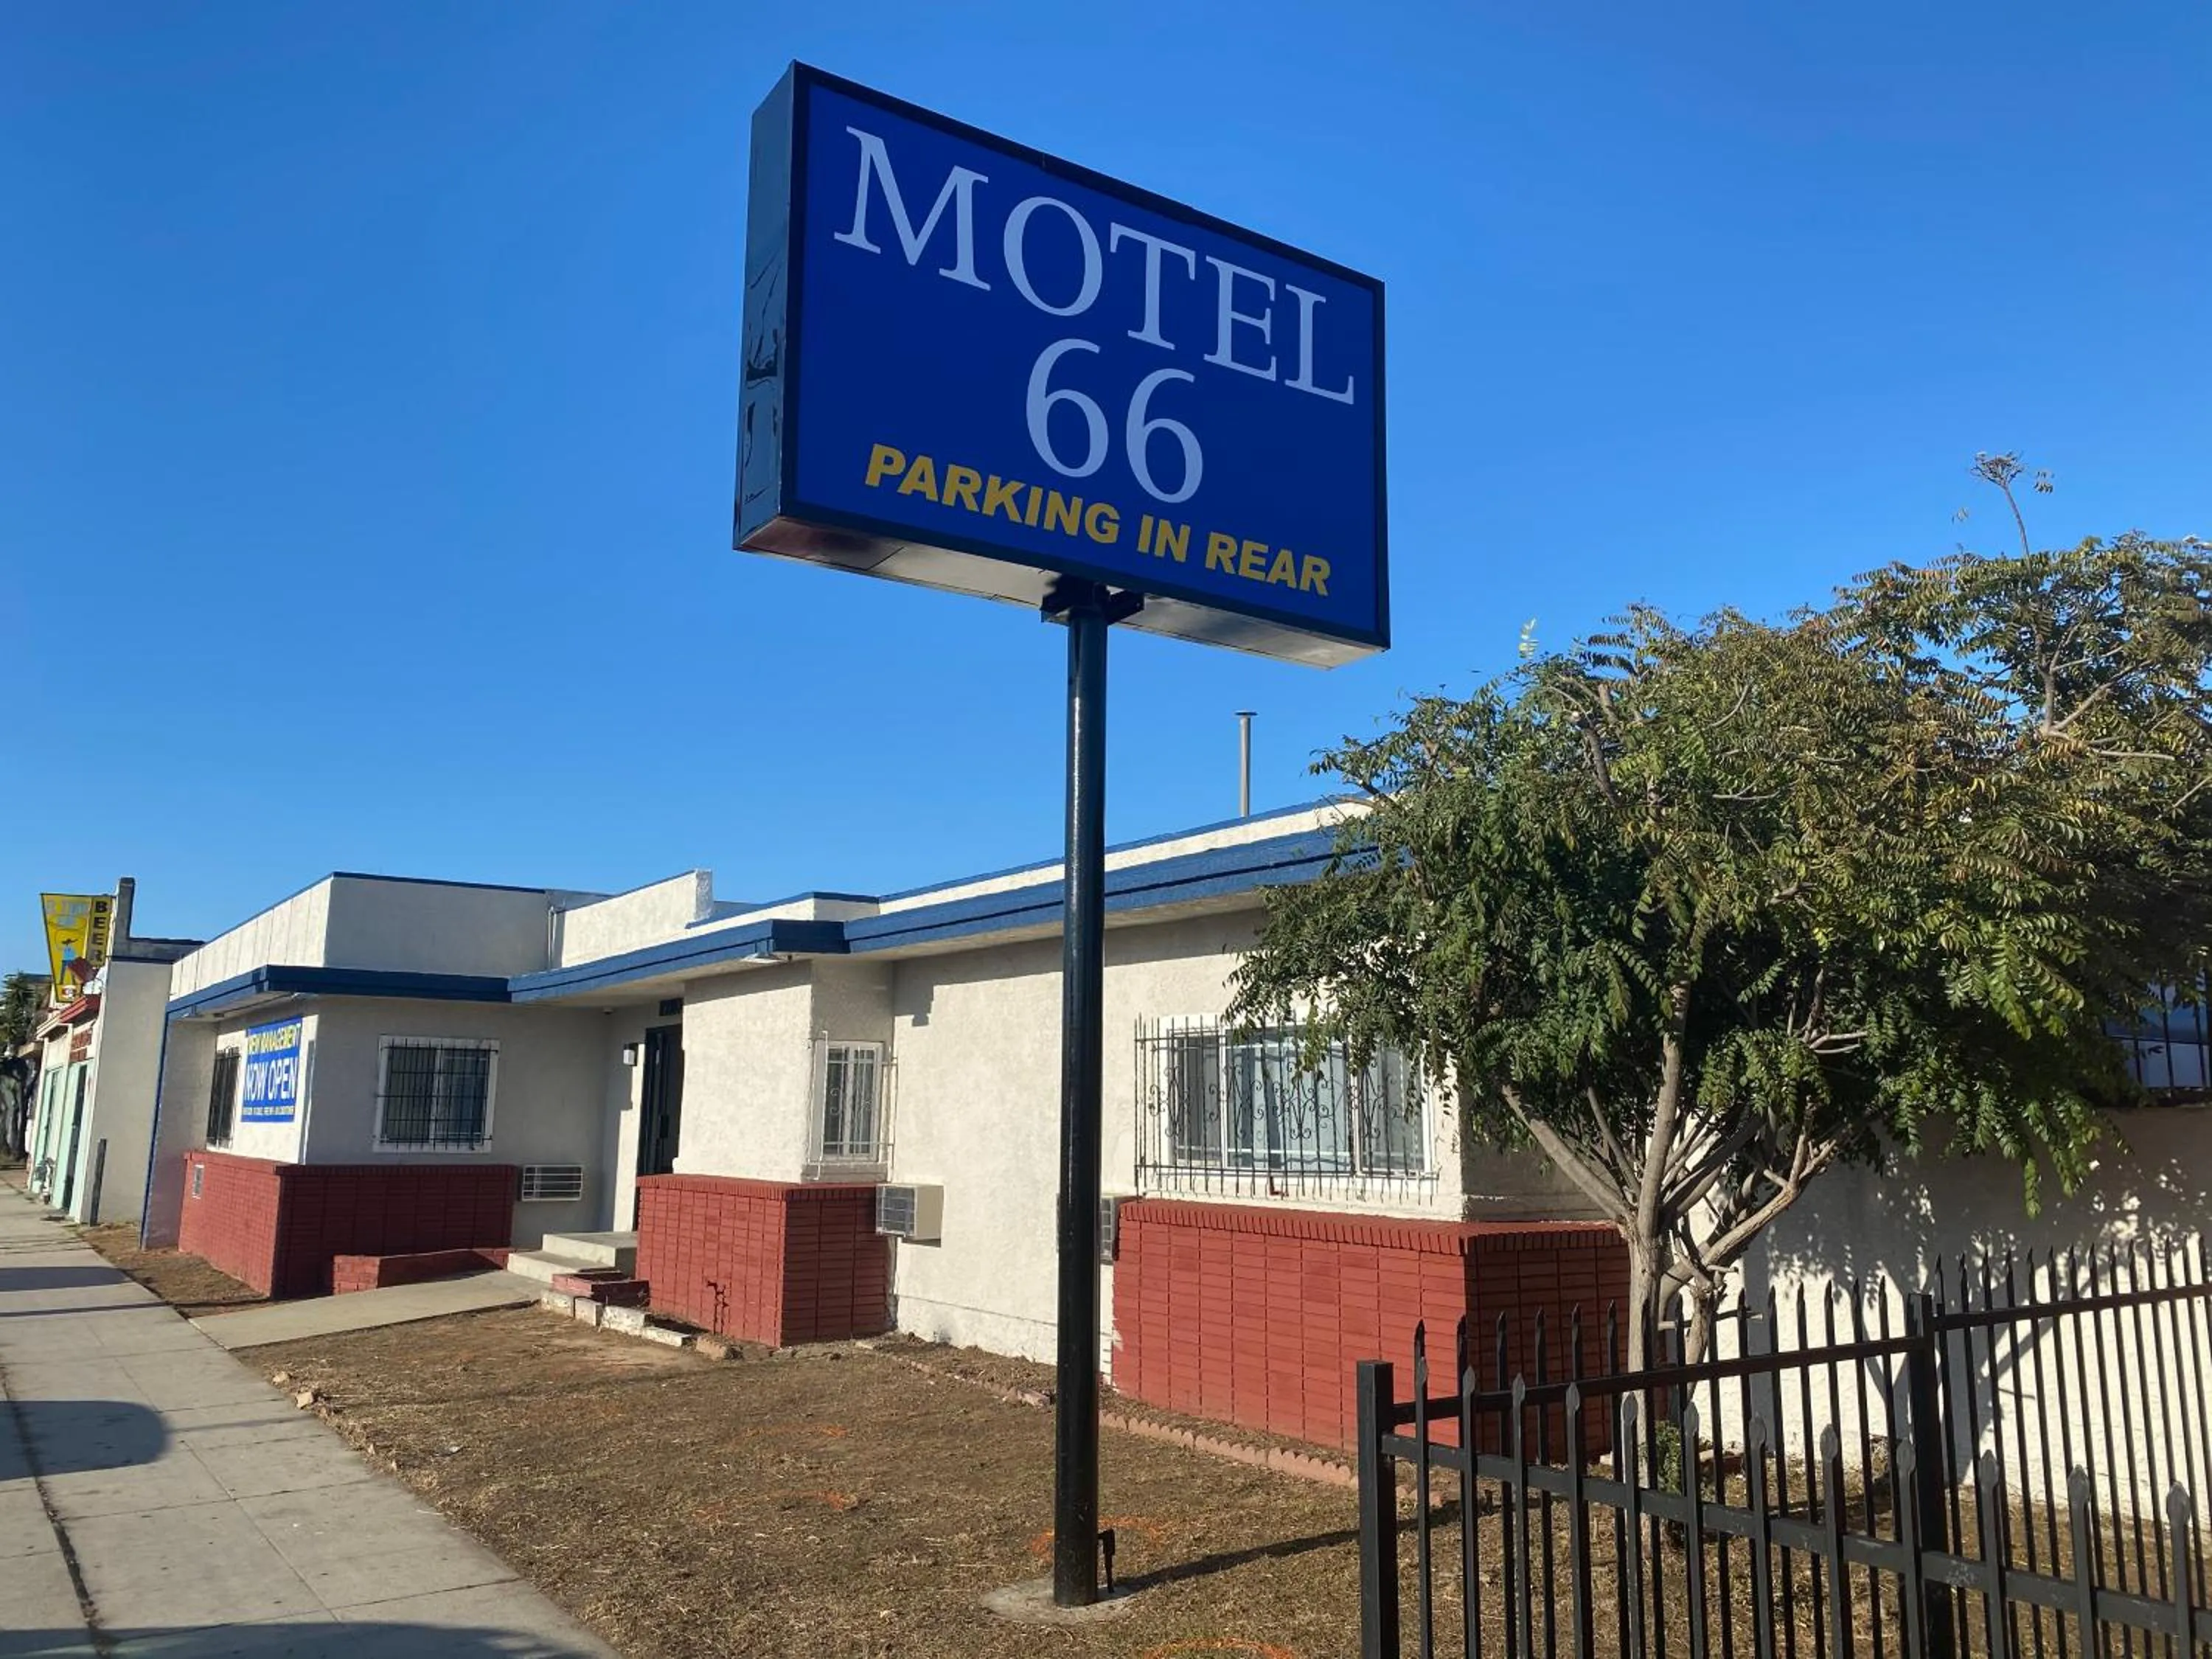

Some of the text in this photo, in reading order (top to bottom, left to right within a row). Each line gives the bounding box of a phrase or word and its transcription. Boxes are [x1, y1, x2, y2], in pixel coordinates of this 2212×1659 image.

[835, 125, 1354, 405] MOTEL
[1026, 338, 1203, 503] 66
[865, 443, 1331, 596] PARKING IN REAR
[91, 900, 108, 962] BEER
[244, 1057, 298, 1101] NOW OPEN
